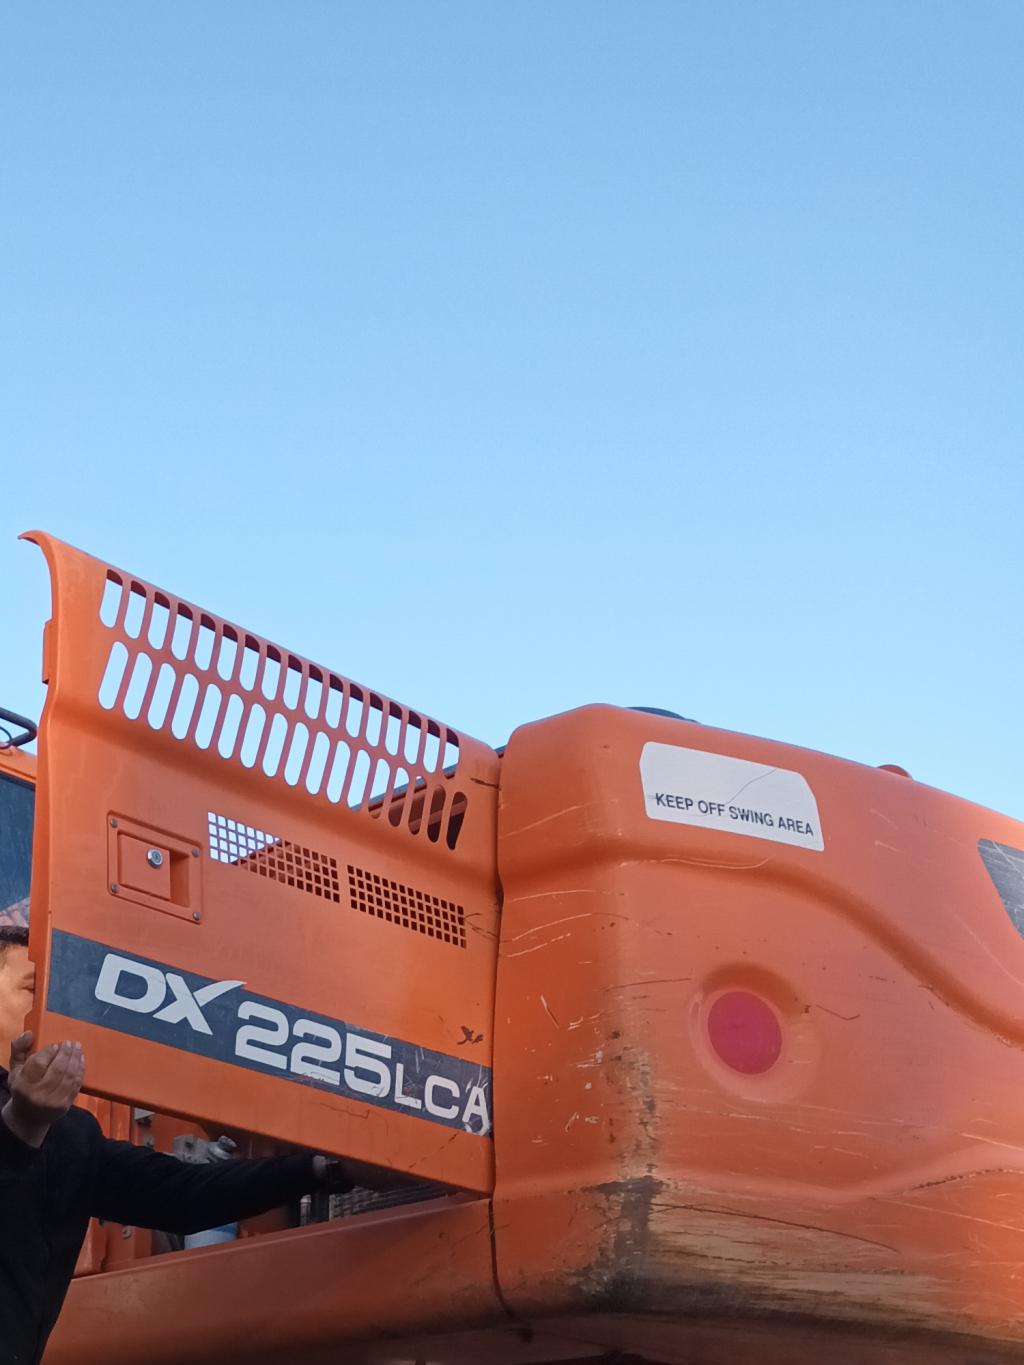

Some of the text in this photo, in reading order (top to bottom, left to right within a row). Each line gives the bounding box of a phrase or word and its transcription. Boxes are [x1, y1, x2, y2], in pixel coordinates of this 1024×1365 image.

[655, 793, 814, 836] KEEP OFF SWING AREA
[94, 952, 248, 1037] DX
